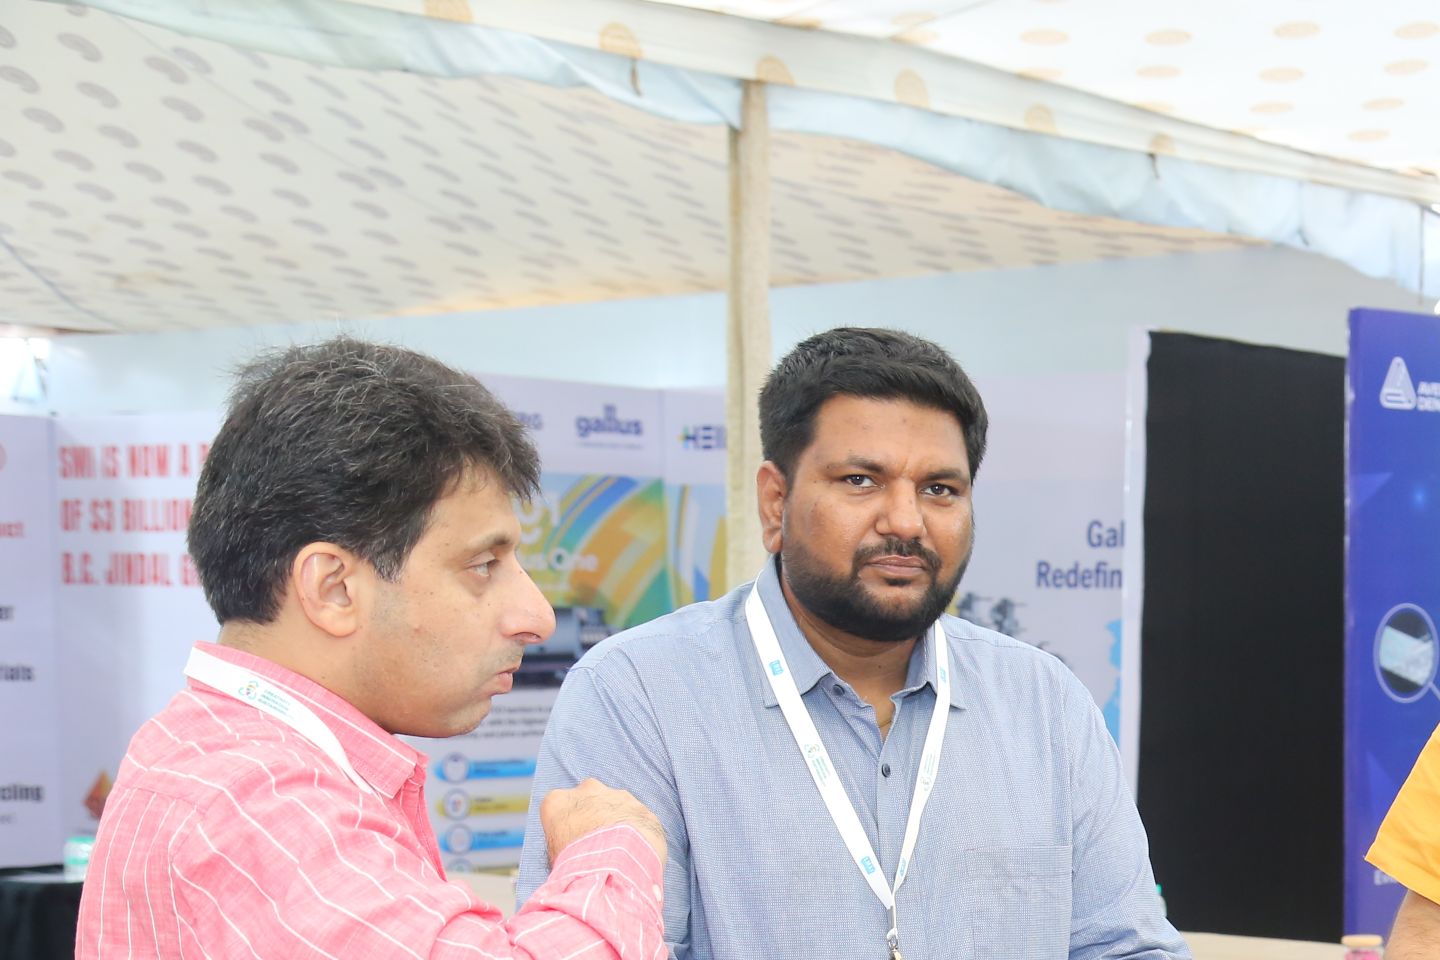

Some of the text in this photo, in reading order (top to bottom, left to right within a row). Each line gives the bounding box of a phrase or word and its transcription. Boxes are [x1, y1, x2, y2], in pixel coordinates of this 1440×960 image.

[128, 444, 168, 477] NOW
[61, 500, 82, 532] OF
[1087, 519, 1124, 548] Gal
[106, 553, 172, 585] JINDAL
[1036, 560, 1122, 588] Redefin
